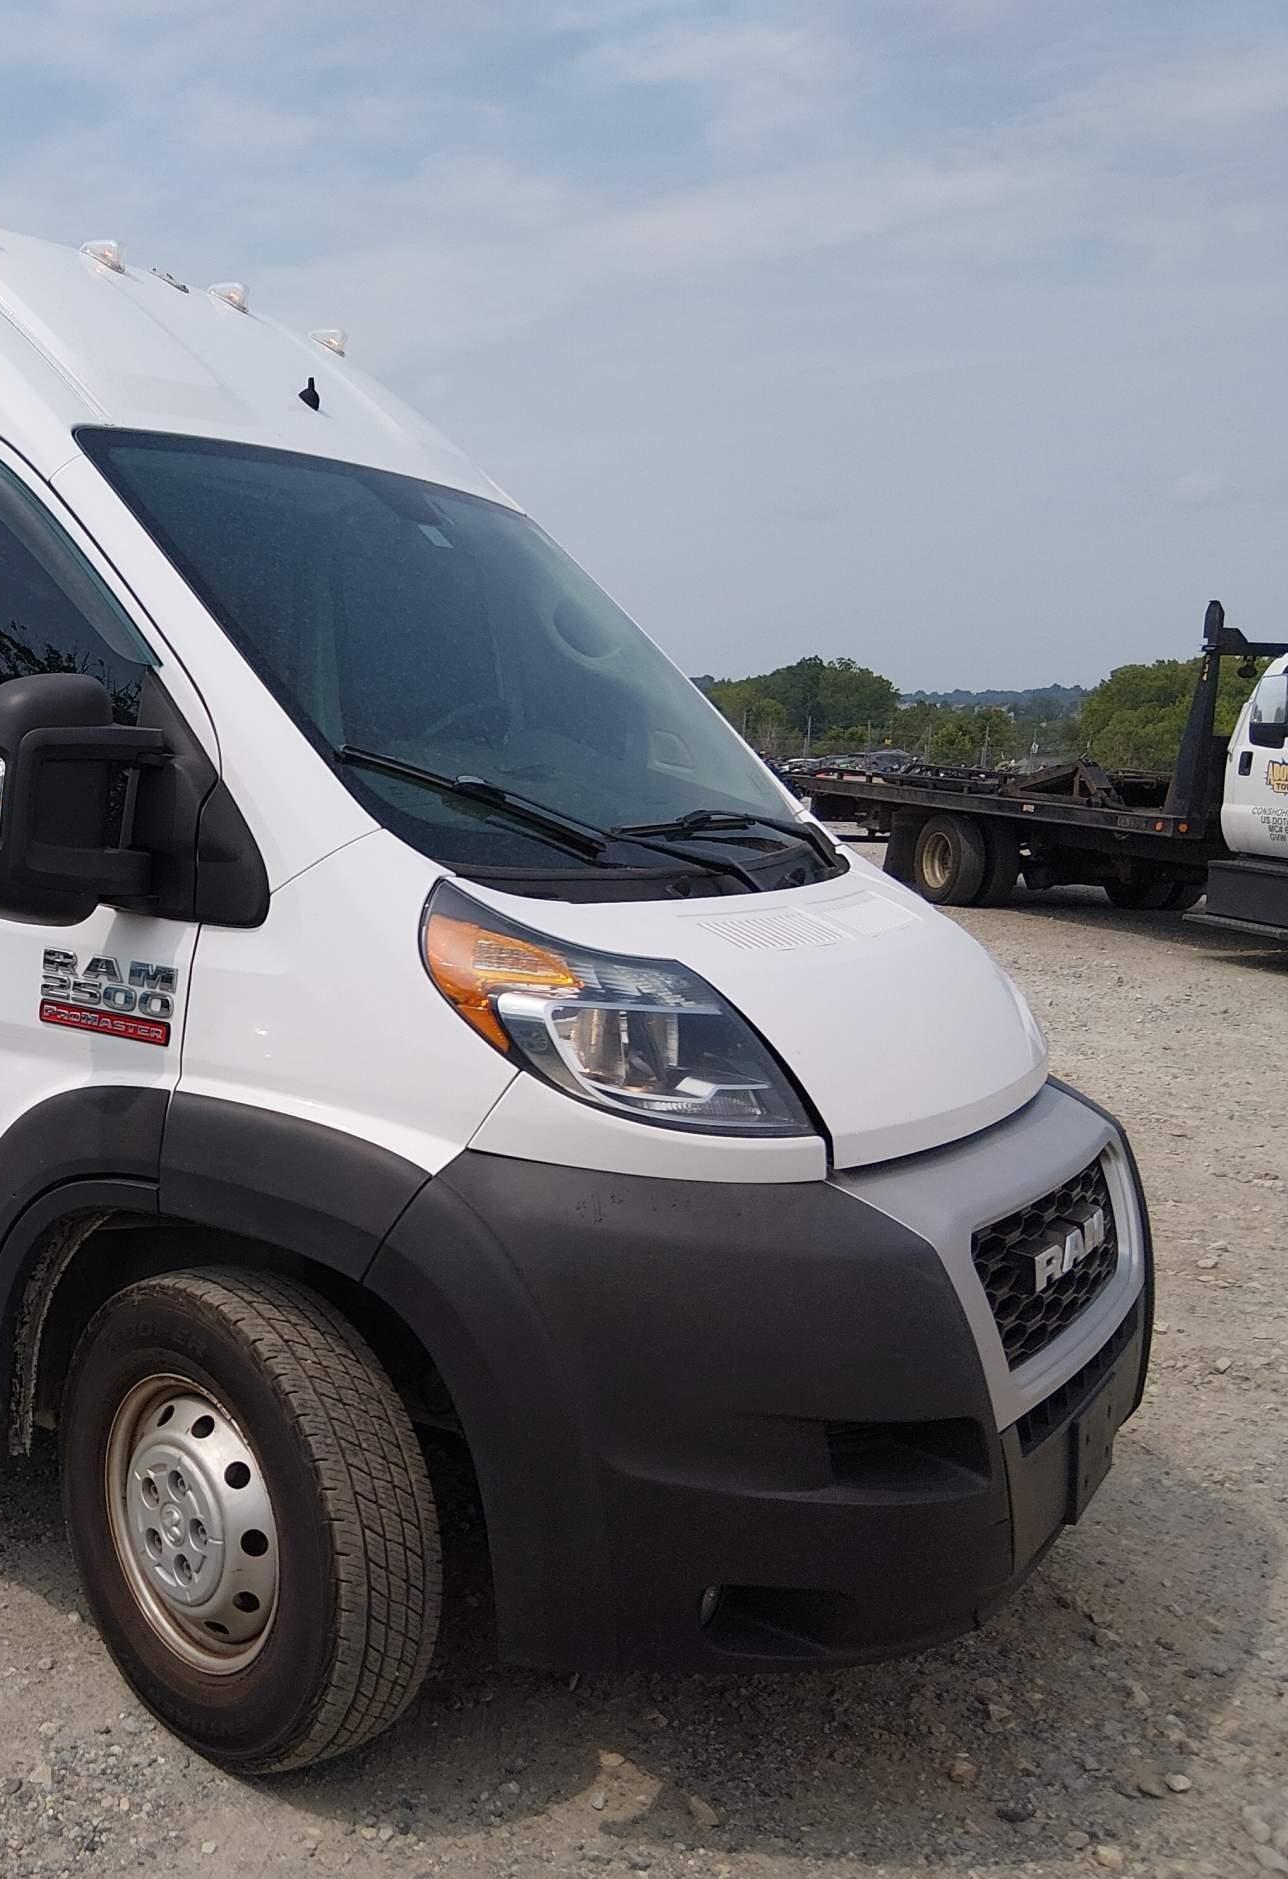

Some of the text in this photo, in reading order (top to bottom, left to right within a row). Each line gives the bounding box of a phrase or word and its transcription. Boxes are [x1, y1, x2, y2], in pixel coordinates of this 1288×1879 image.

[1275, 783, 1288, 791] TO
[1261, 816, 1271, 824] US
[42, 948, 179, 993] RAM
[41, 974, 174, 1019] 2500
[1033, 1208, 1105, 1293] RAM
